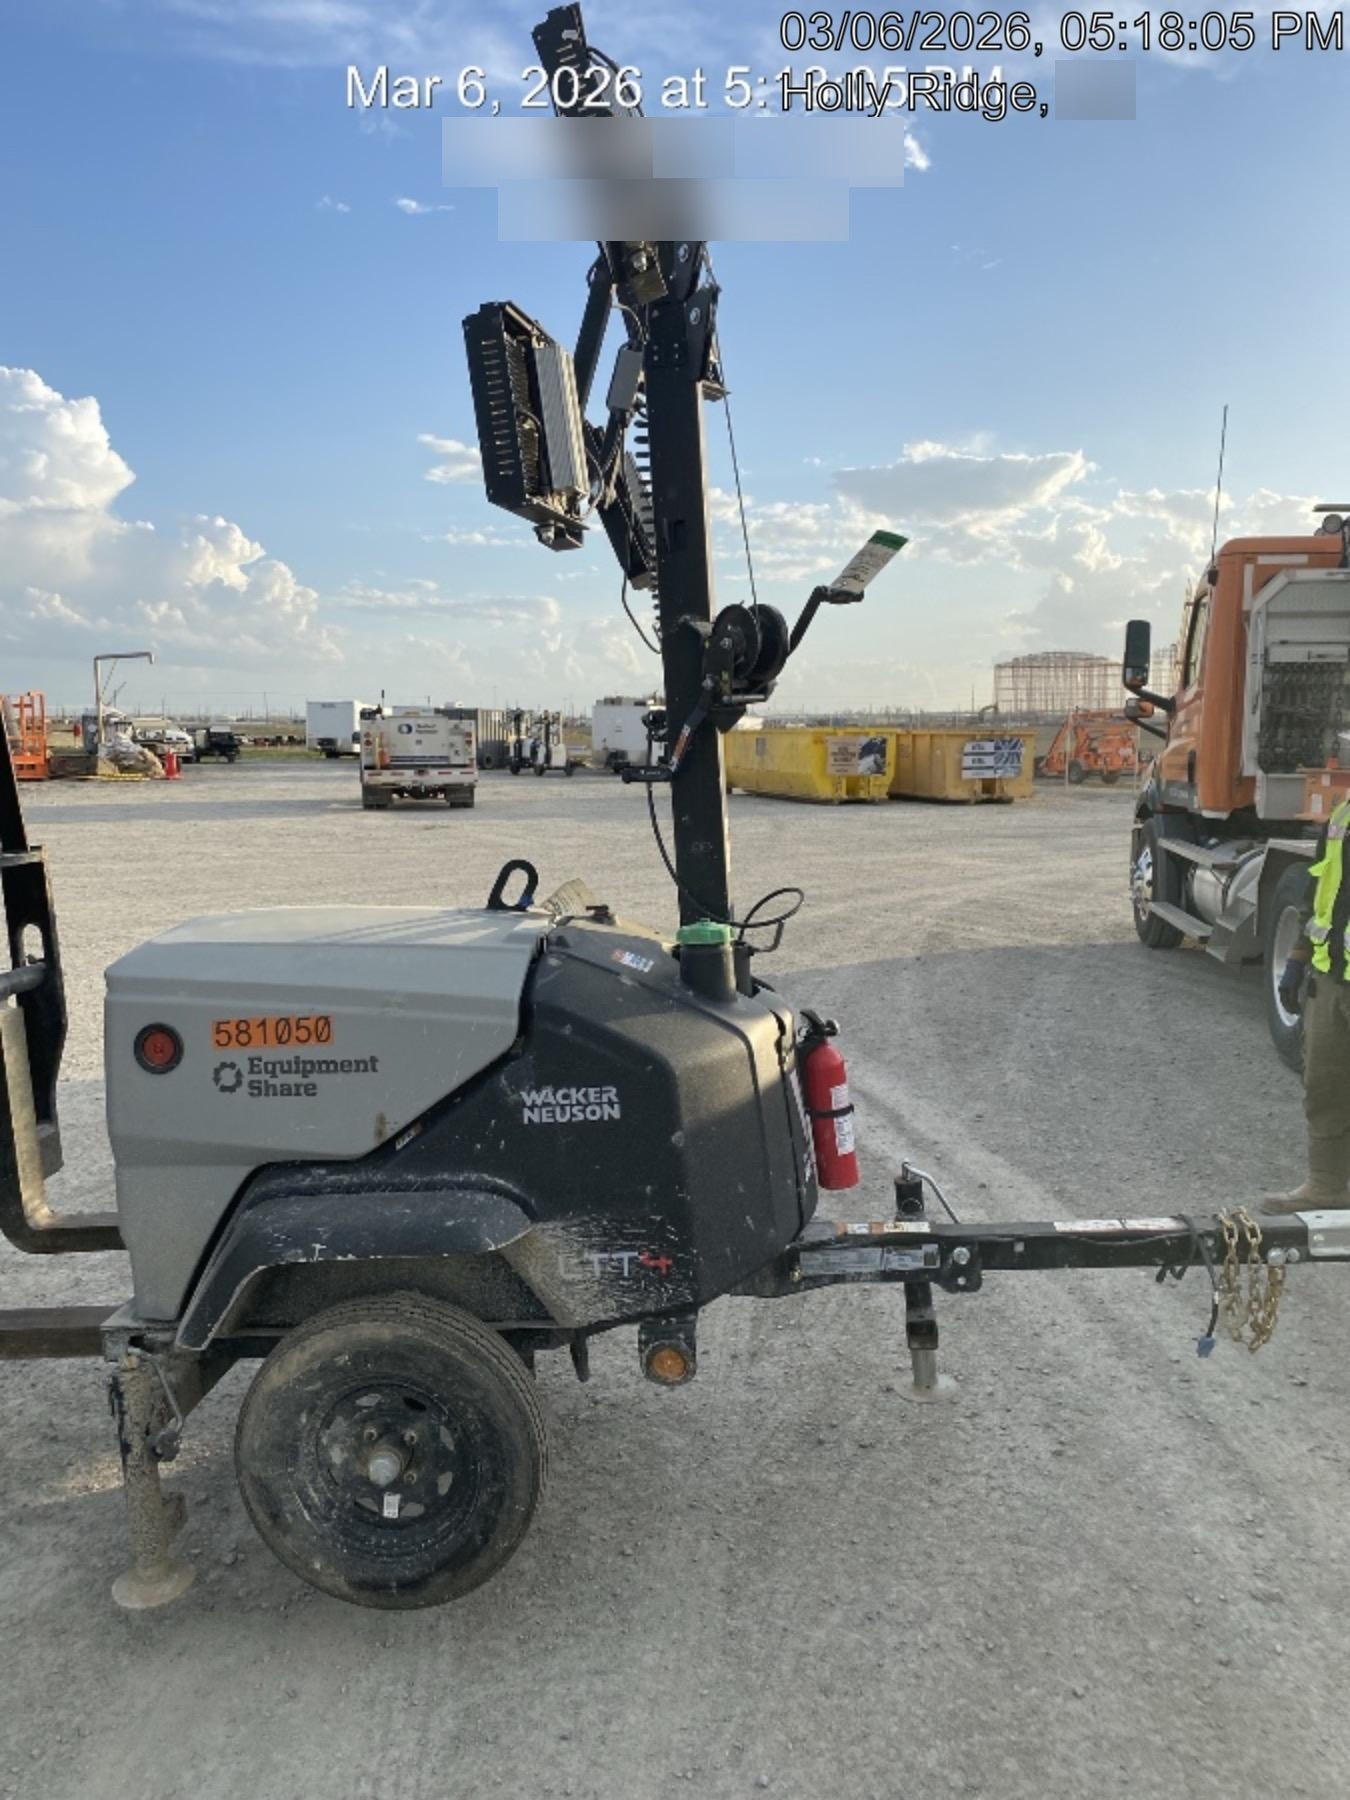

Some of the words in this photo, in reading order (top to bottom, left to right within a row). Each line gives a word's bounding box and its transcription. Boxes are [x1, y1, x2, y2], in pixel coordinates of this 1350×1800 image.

[214, 1015, 332, 1048] 581050
[247, 1055, 380, 1079] Equipment
[247, 1079, 318, 1098] Share
[520, 1085, 620, 1107] WACKER
[522, 1103, 621, 1125] NEUSON
